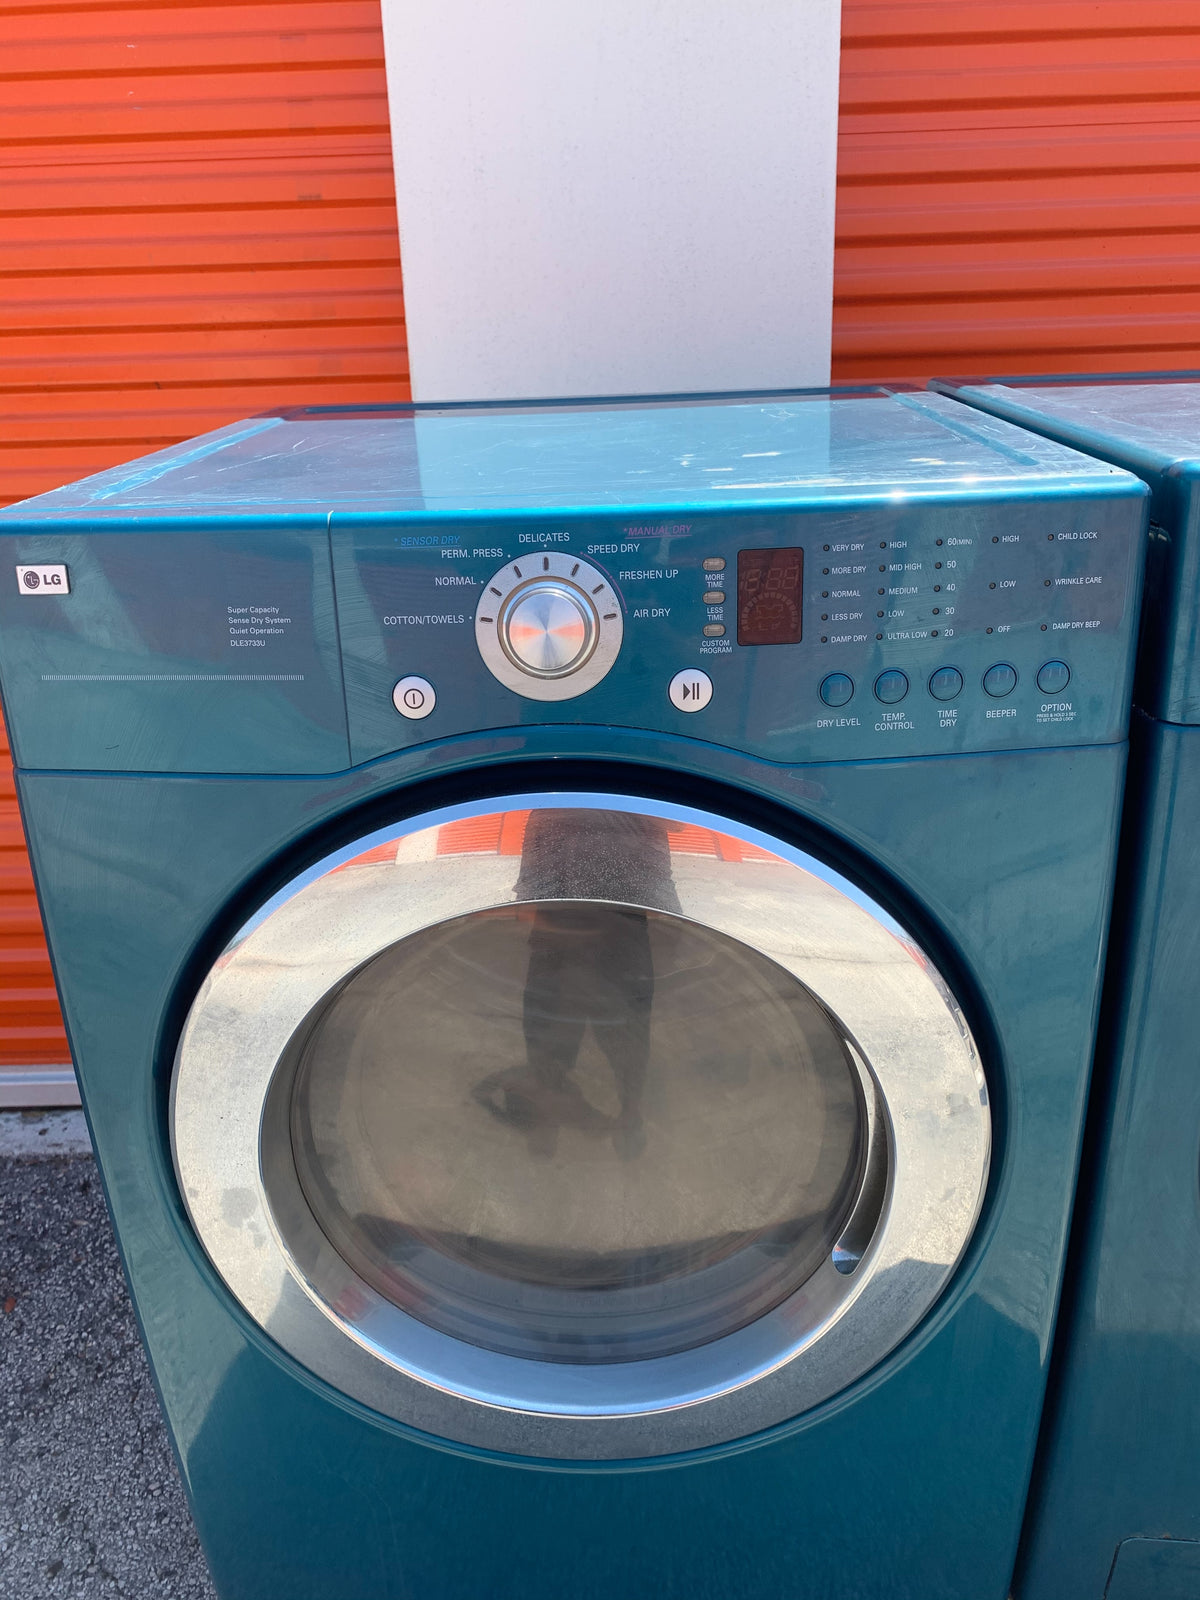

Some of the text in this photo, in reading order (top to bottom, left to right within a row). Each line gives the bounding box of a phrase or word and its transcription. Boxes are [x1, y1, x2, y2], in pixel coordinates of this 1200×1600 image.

[628, 524, 692, 536] MANUAL DRY
[400, 535, 460, 546] SENSOR DRY
[518, 532, 570, 543] DELICATES
[1058, 532, 1098, 540] CHILD LOCK
[588, 544, 640, 554] SPEED DRY
[890, 541, 907, 549] HIGH
[441, 548, 504, 558] PERM. PRESS
[946, 560, 956, 568] 50
[620, 569, 678, 580] FRESHEN UP
[832, 567, 851, 575] MORE
[43, 574, 61, 586] LG
[435, 576, 476, 586] NORMAL
[888, 587, 918, 595] MEDIUM
[250, 606, 280, 614] Capacity
[634, 608, 671, 618] AIR DRY
[945, 607, 954, 615] 30
[251, 616, 264, 624] Dry
[264, 616, 292, 624] System
[384, 614, 464, 625] COTTON/TOWELS
[1052, 622, 1070, 630] DAMP
[1085, 620, 1100, 628] BEEP
[250, 627, 284, 635] Operation
[888, 631, 928, 640] ULTRA LOW
[944, 629, 954, 637] 20
[1041, 703, 1072, 712] OPTION
[882, 712, 906, 722] TEMP.
[938, 710, 958, 718] TIME
[986, 709, 1016, 718] BEEPER
[816, 718, 860, 728] DRY LEVEL
[874, 722, 914, 731] CONTROL
[940, 719, 957, 728] DRY
